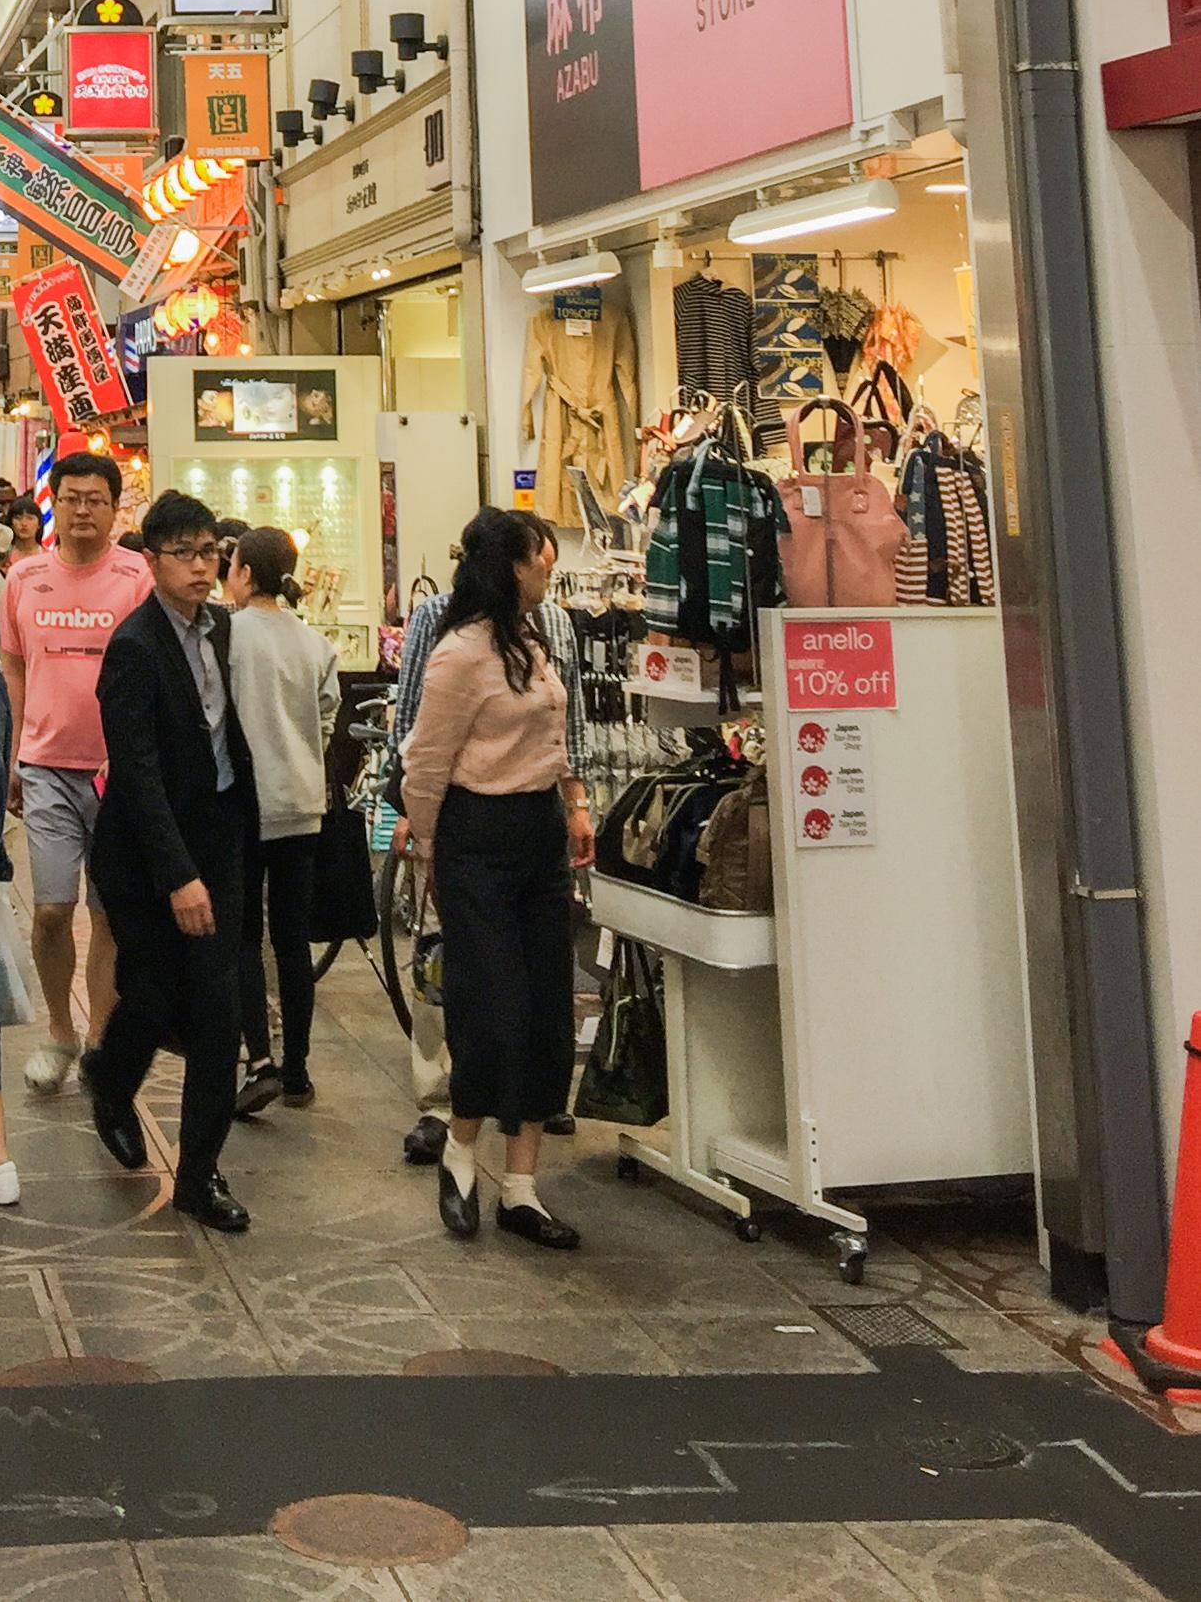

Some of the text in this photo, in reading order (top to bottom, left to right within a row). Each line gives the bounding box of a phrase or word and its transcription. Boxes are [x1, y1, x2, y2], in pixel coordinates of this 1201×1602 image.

[208, 63, 243, 78] 天五
[556, 51, 599, 102] AZABU
[35, 608, 114, 628] umbro
[802, 626, 874, 651] anello
[793, 670, 890, 696] 10% off
